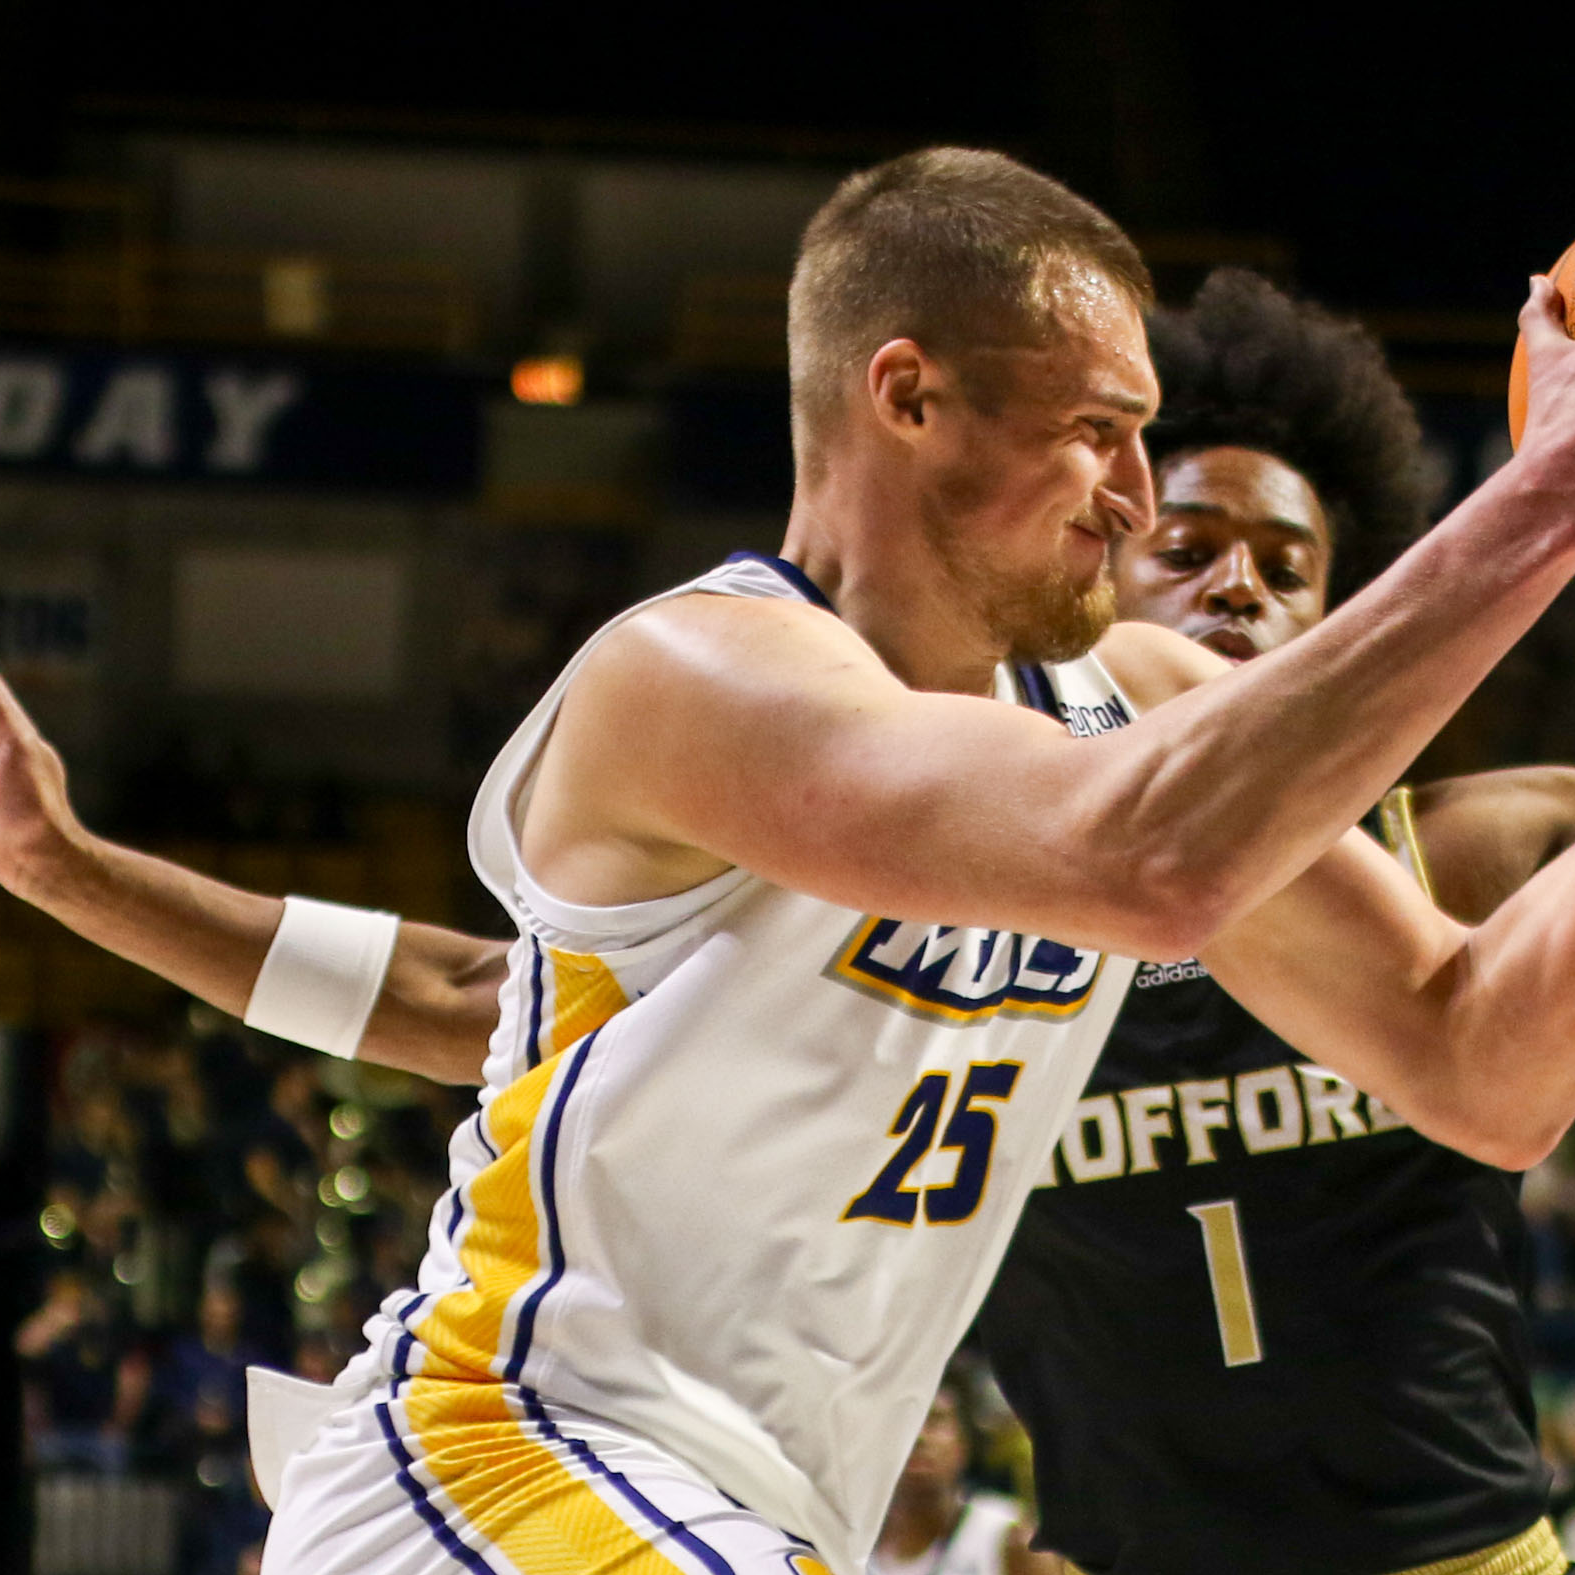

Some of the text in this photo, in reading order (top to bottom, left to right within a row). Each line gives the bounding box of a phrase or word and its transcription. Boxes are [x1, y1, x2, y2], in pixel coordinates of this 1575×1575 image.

[1136, 965, 1209, 988] adidas
[837, 1058, 1026, 1229] 25
[1032, 1063, 1413, 1189] OFFOR
[1186, 1200, 1262, 1367] 1
